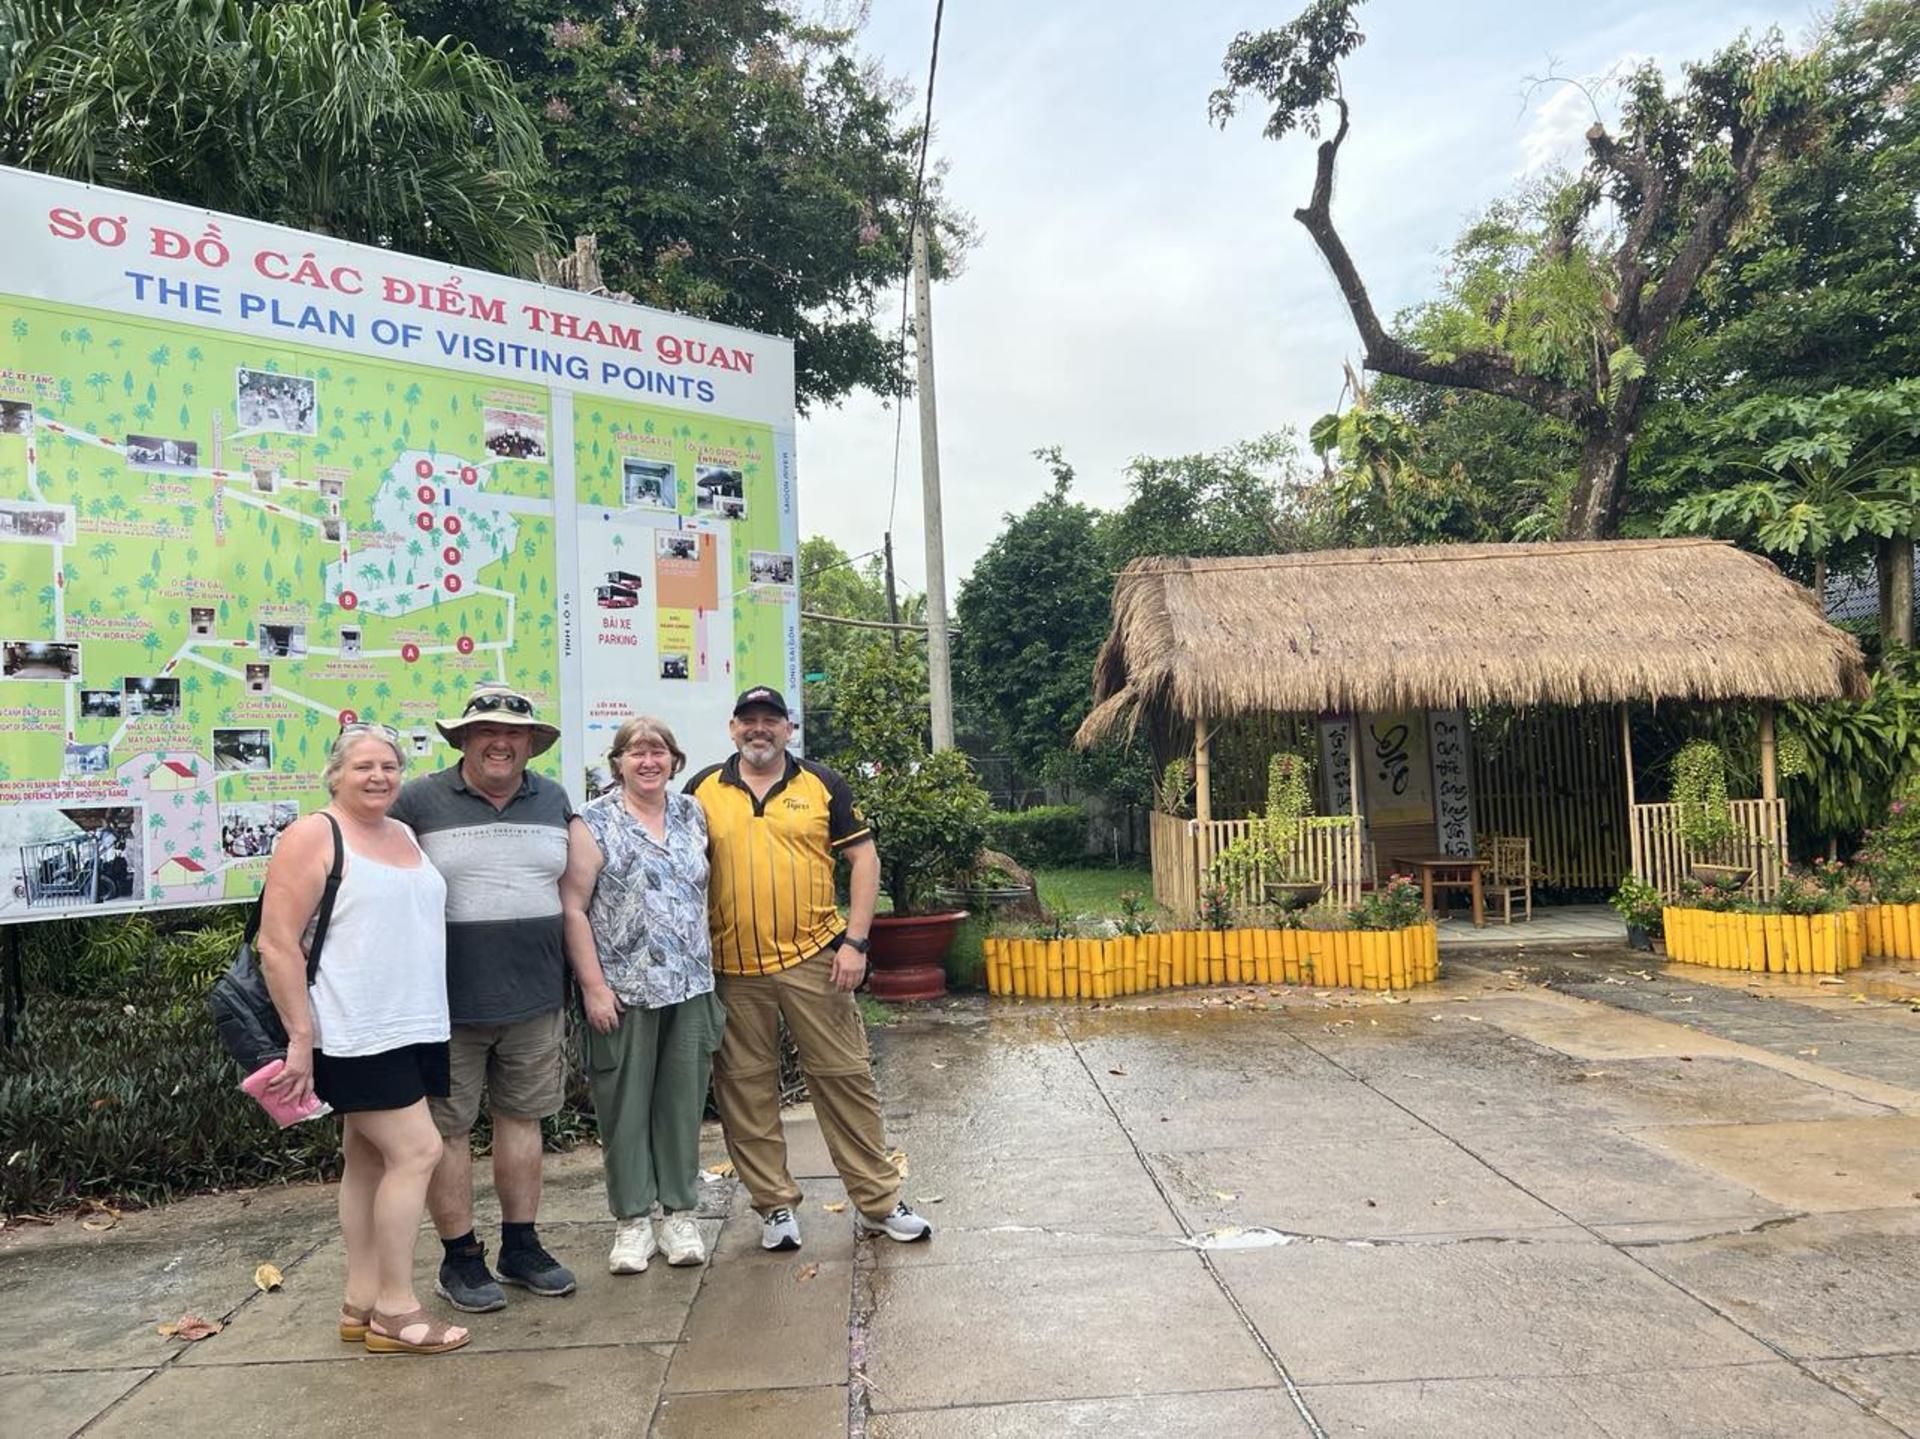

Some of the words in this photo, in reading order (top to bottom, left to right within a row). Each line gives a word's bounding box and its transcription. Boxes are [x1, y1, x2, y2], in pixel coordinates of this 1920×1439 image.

[48, 206, 128, 248] SƠ
[150, 222, 230, 268] ĐỒ
[254, 252, 364, 295] CÁC
[382, 275, 508, 325] ĐIỂM
[522, 304, 643, 353] THAM
[655, 334, 755, 375] QUAN
[125, 271, 222, 315] THE
[240, 292, 356, 339] PLAN
[371, 318, 423, 348] OF
[437, 329, 590, 381] VISITING
[601, 361, 715, 402] POINTS
[598, 633, 638, 646] PARKING
[619, 618, 632, 630] XE
